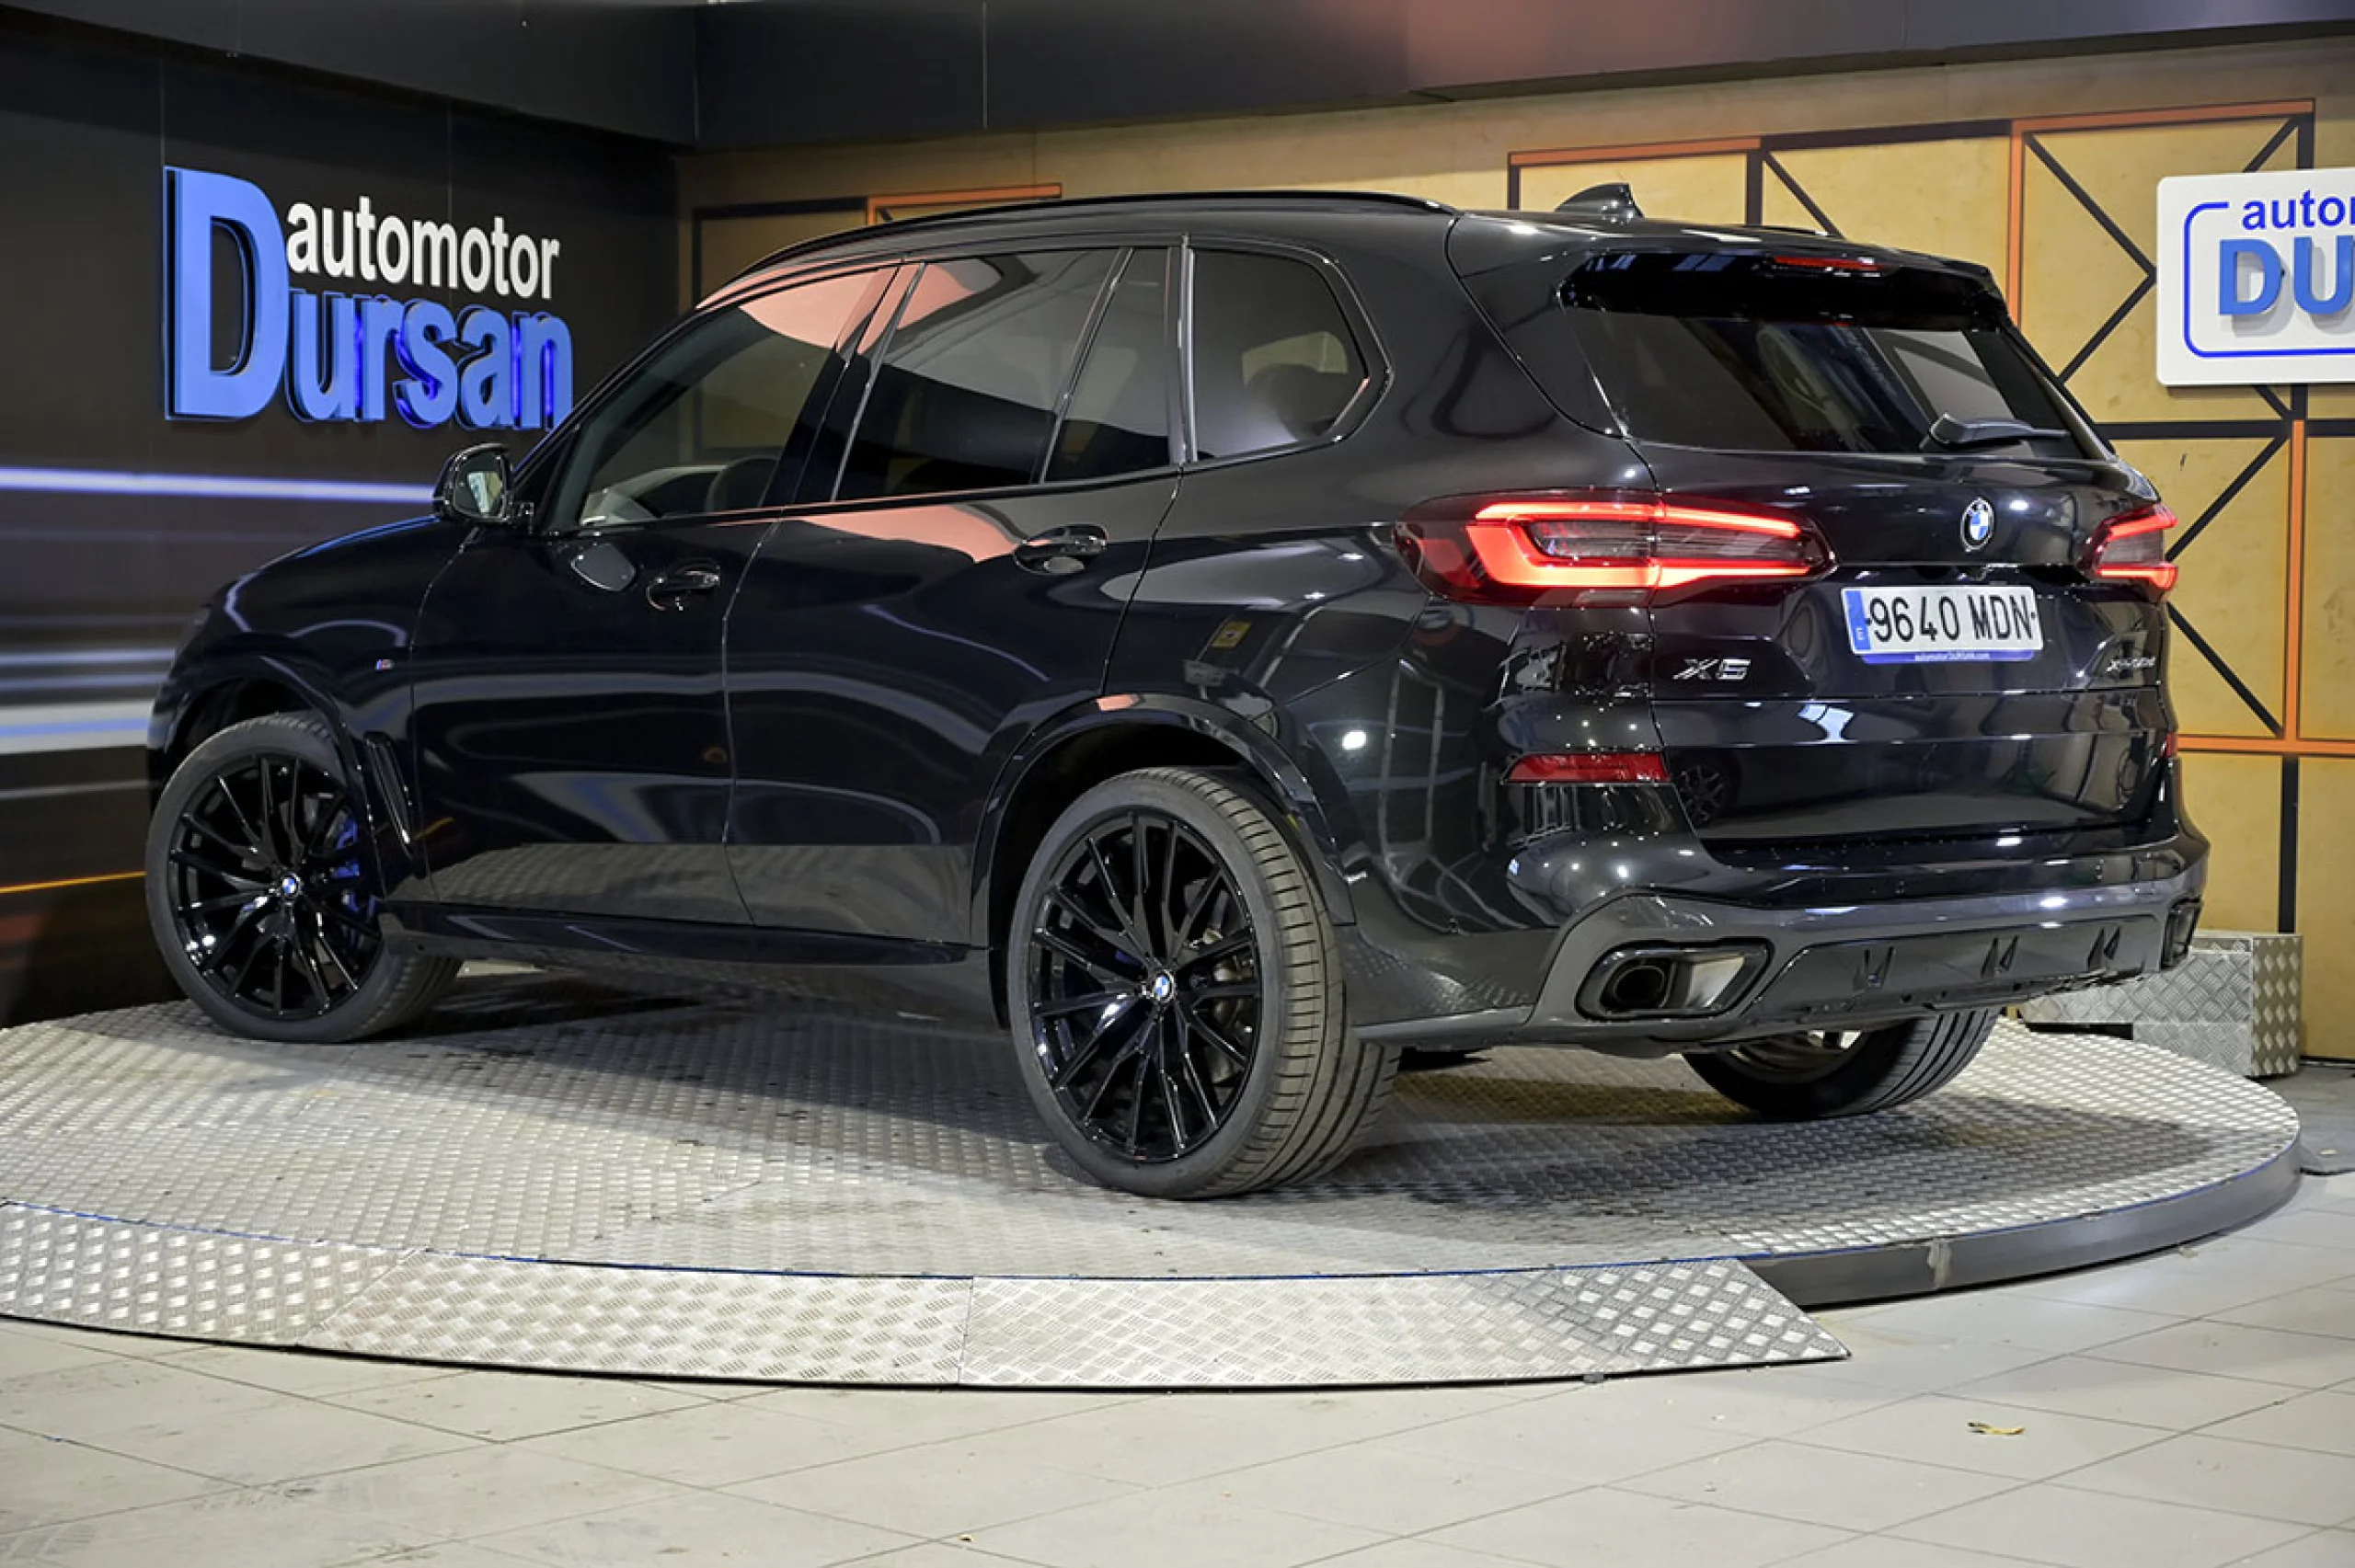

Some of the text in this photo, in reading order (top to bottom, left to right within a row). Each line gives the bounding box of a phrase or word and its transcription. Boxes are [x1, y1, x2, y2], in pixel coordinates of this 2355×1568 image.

[2242, 189, 2355, 230] auto
[286, 196, 559, 299] automotor
[163, 165, 574, 430] Dursan
[1855, 627, 1866, 641] E
[1869, 595, 2033, 642] 9640 MDN
[1672, 658, 1752, 680] X5
